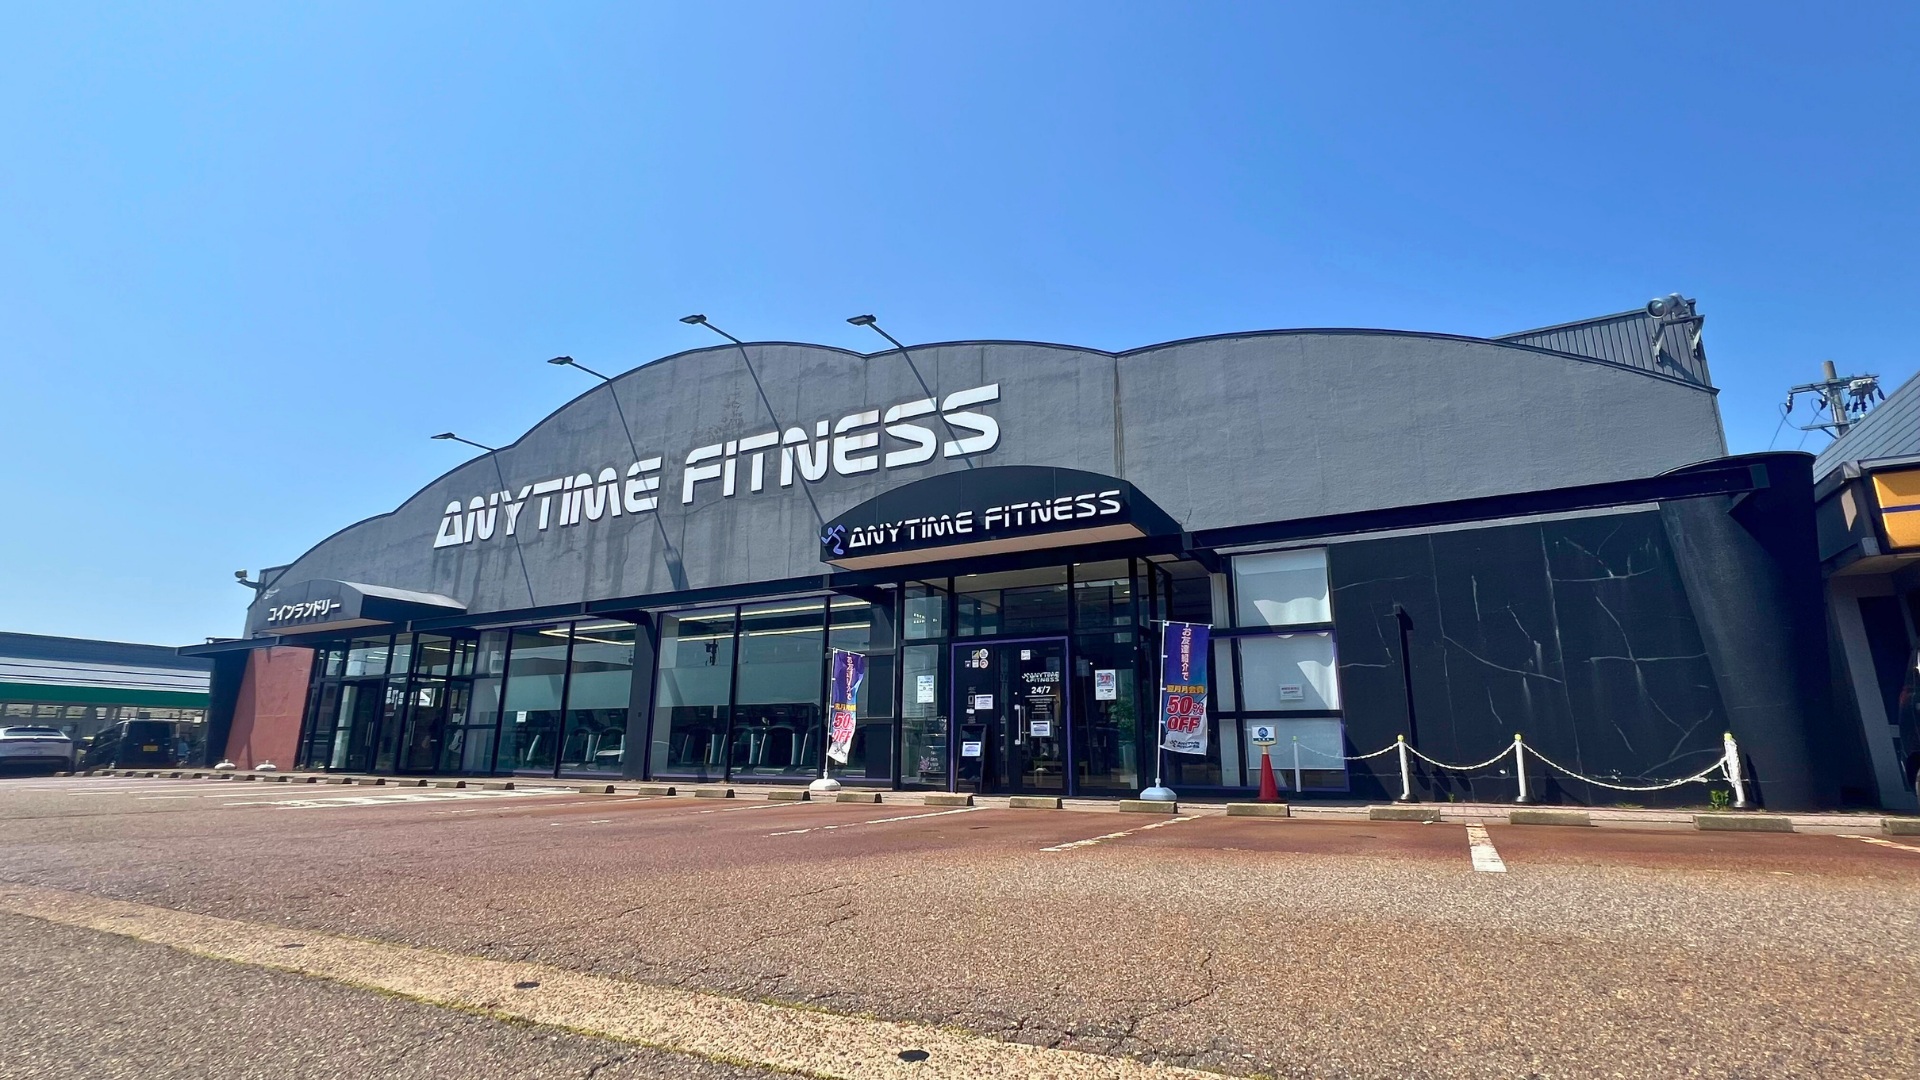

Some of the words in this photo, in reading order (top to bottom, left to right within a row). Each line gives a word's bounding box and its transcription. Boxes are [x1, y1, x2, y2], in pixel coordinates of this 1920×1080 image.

[434, 457, 663, 550] ANYTIME
[682, 383, 1000, 505] FITNESS
[849, 510, 973, 548] ANYTIME
[985, 489, 1121, 530] FITNESS
[267, 598, 341, 622] コインランドリー
[1031, 686, 1051, 694] 24/7
[1166, 694, 1205, 716] 50%
[1166, 715, 1202, 734] OFF
